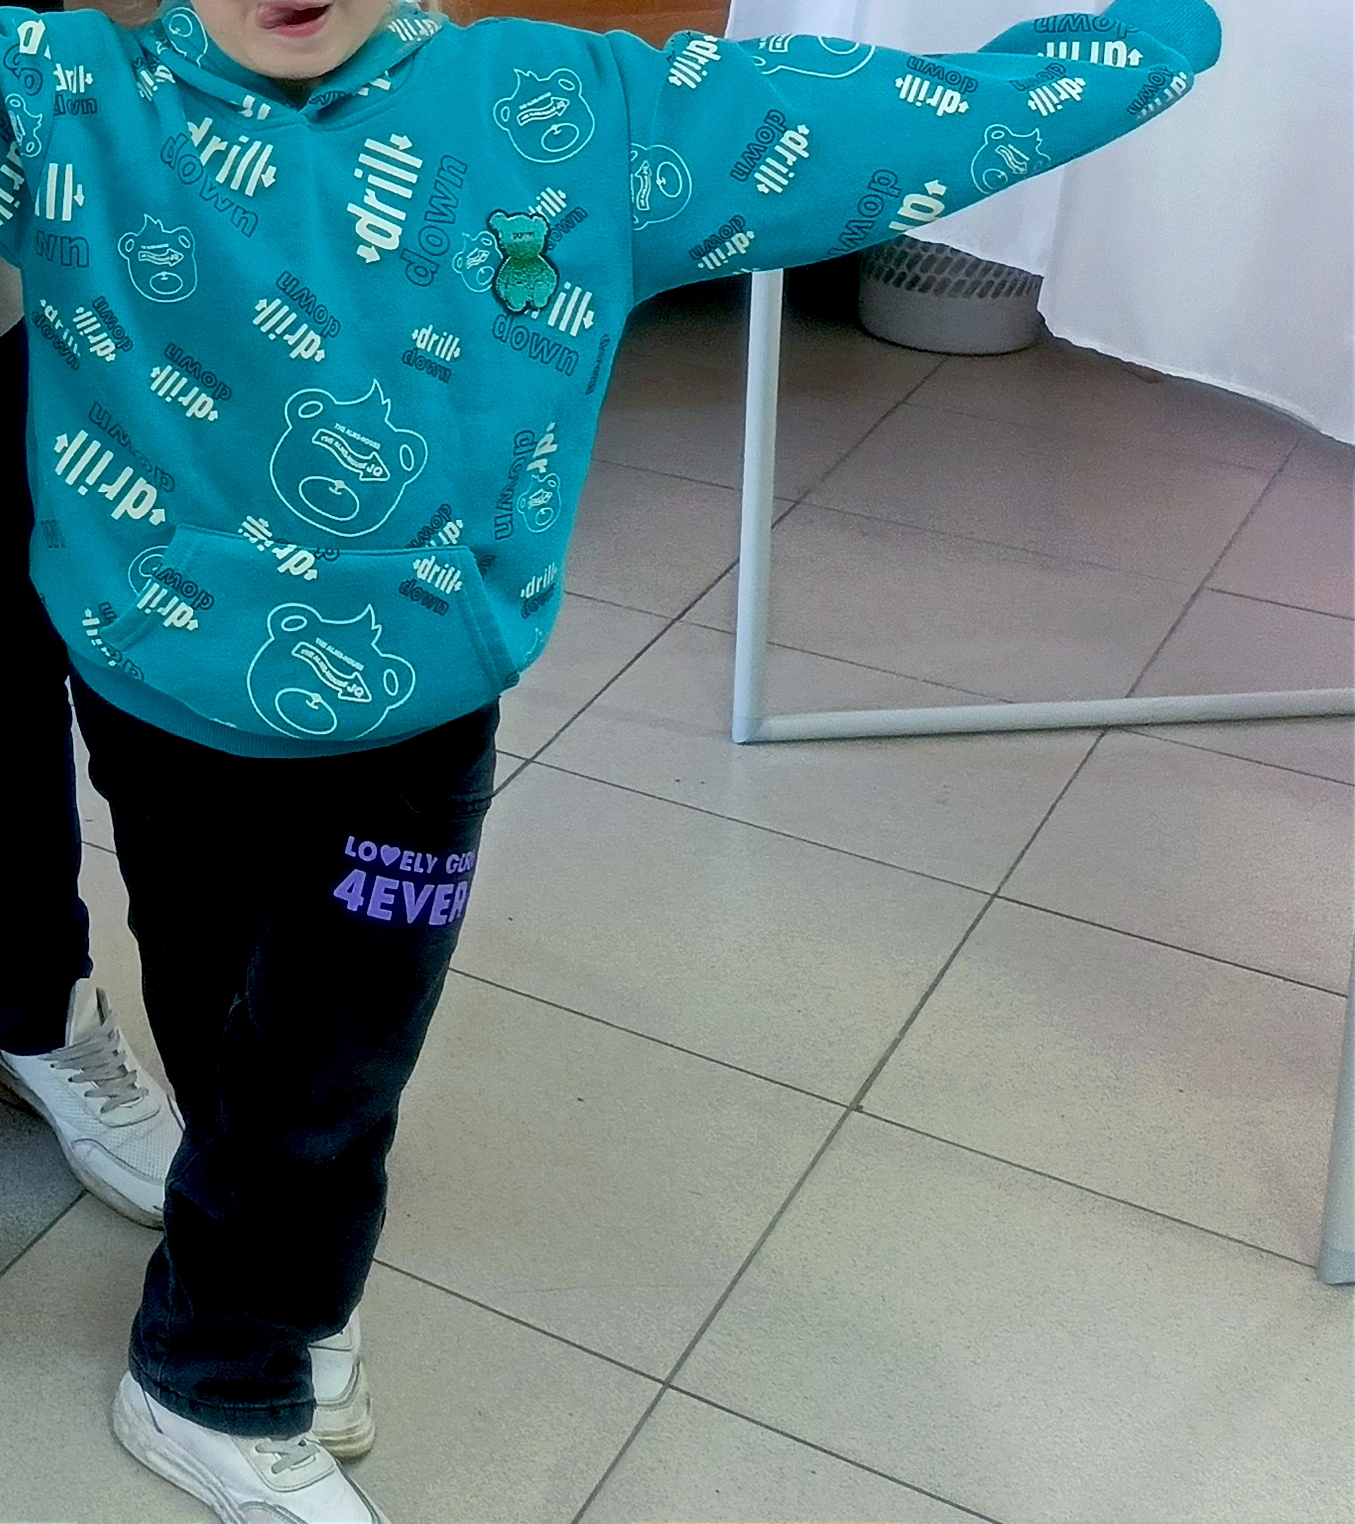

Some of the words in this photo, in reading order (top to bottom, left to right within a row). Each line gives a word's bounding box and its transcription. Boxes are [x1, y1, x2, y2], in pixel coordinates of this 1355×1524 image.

[899, 74, 966, 116] drill
[907, 56, 978, 94] down
[1029, 76, 1084, 116] drill
[731, 109, 786, 182] down
[754, 128, 810, 194] drill
[161, 133, 259, 238] down
[347, 138, 423, 251] drill
[401, 154, 468, 287] down
[92, 296, 133, 352] down
[252, 299, 325, 358] drill
[276, 271, 341, 338] down
[73, 310, 115, 360] drill
[417, 325, 459, 361] drill
[493, 314, 578, 376] down
[150, 366, 214, 418] drill
[164, 343, 231, 401] down
[403, 348, 451, 383] down
[55, 430, 157, 520] drill
[416, 556, 462, 594] drill
